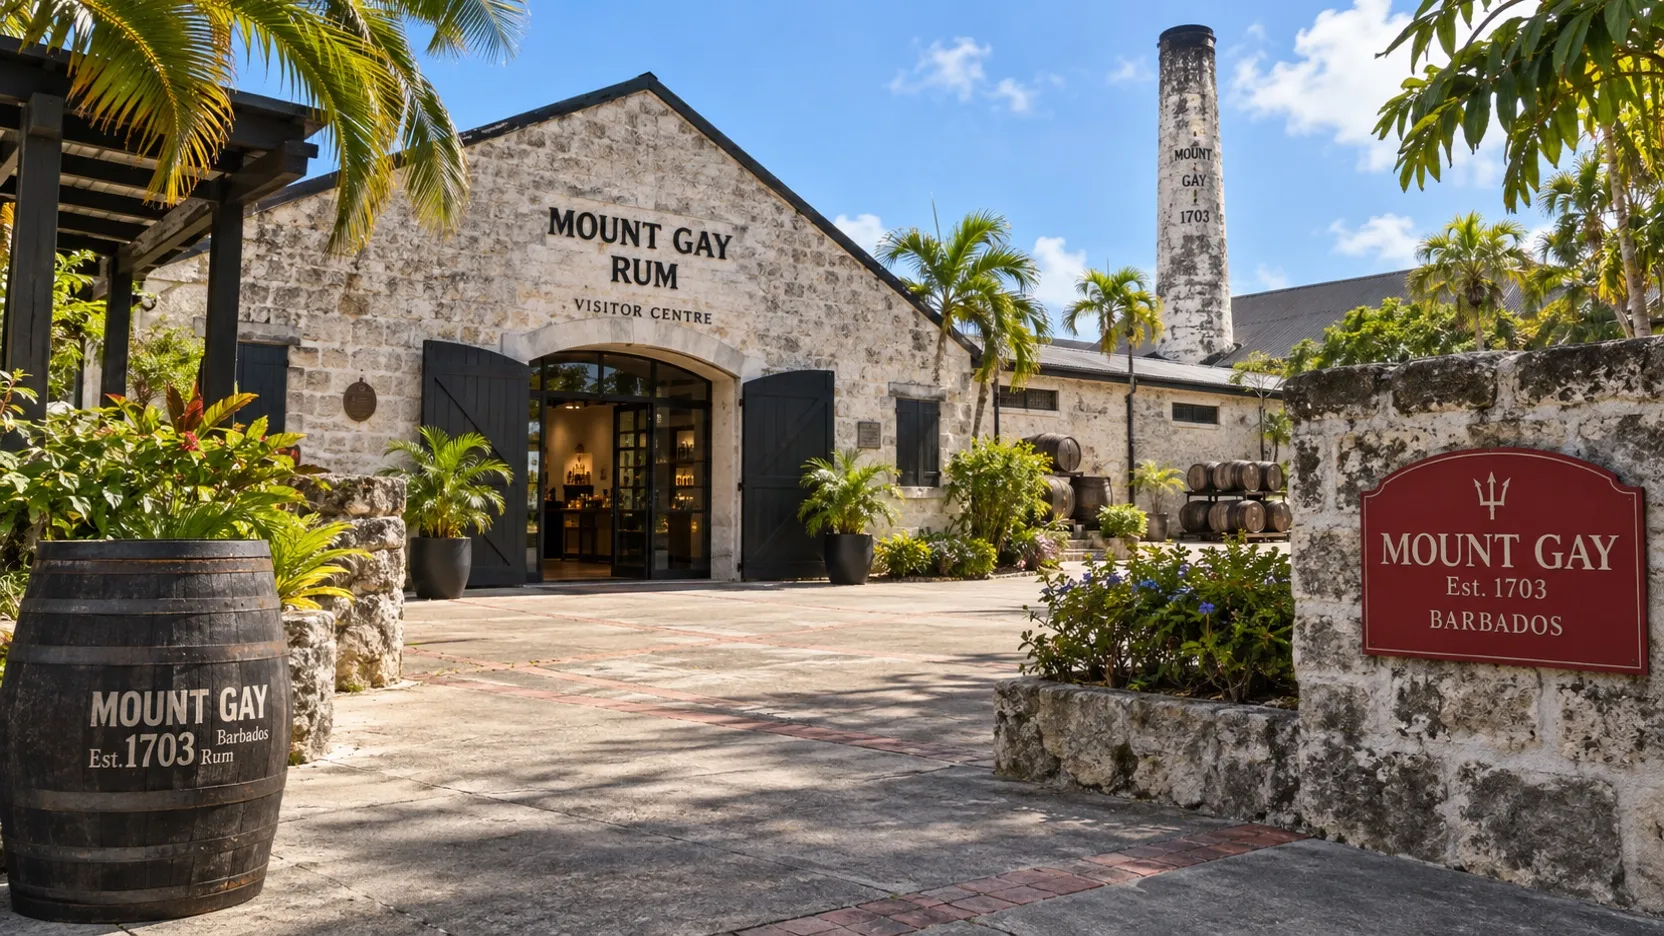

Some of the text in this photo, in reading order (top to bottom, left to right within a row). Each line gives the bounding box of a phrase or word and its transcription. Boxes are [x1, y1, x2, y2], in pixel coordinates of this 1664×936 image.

[1174, 147, 1213, 161] MOUNT
[1182, 174, 1207, 187] GAY
[1180, 209, 1210, 224] 1703
[547, 206, 733, 260] MOUNT GAY
[610, 255, 678, 290] RUM
[573, 298, 712, 325] VISITOR CENTRE
[1380, 532, 1620, 571] MOUNT GAY
[1446, 576, 1547, 600] Est. 1703
[1429, 609, 1563, 637] BARBADOS
[90, 684, 268, 727] MOUNT GAY
[216, 726, 269, 746] Barbados
[88, 731, 195, 769] Est. 1703
[201, 749, 234, 765] Rum
